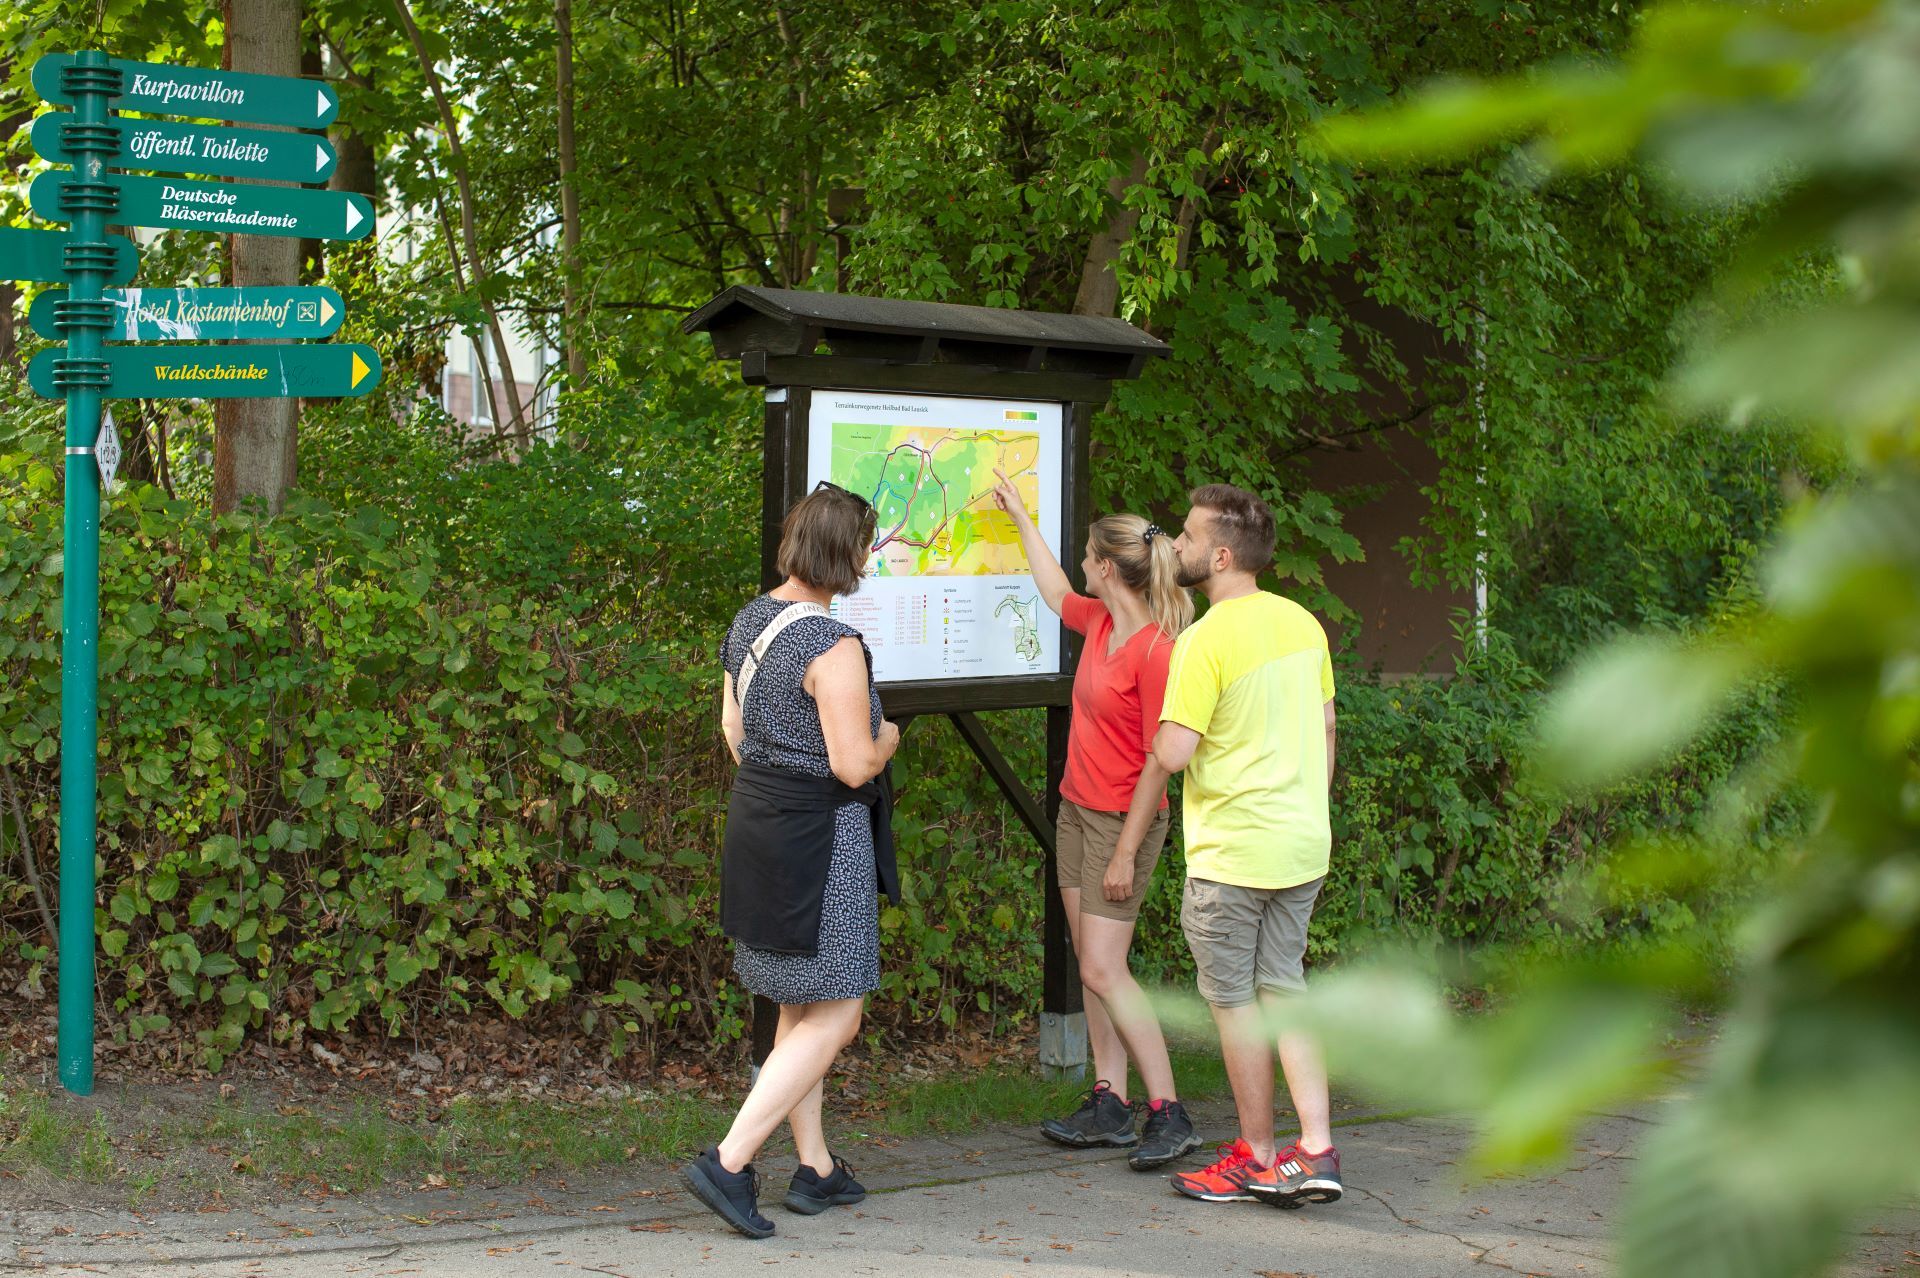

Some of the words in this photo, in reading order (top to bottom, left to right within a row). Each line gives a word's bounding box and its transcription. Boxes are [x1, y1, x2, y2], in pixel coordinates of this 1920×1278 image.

[130, 74, 245, 105] Kurpavillon
[130, 130, 196, 160] öffentl.
[202, 136, 269, 163] Toilette
[160, 186, 238, 206] Deutsche
[160, 204, 298, 229] Bläserakademie
[124, 299, 171, 324] Hotel
[175, 298, 294, 329] Kastanienhof
[154, 363, 269, 381] Waldschänke
